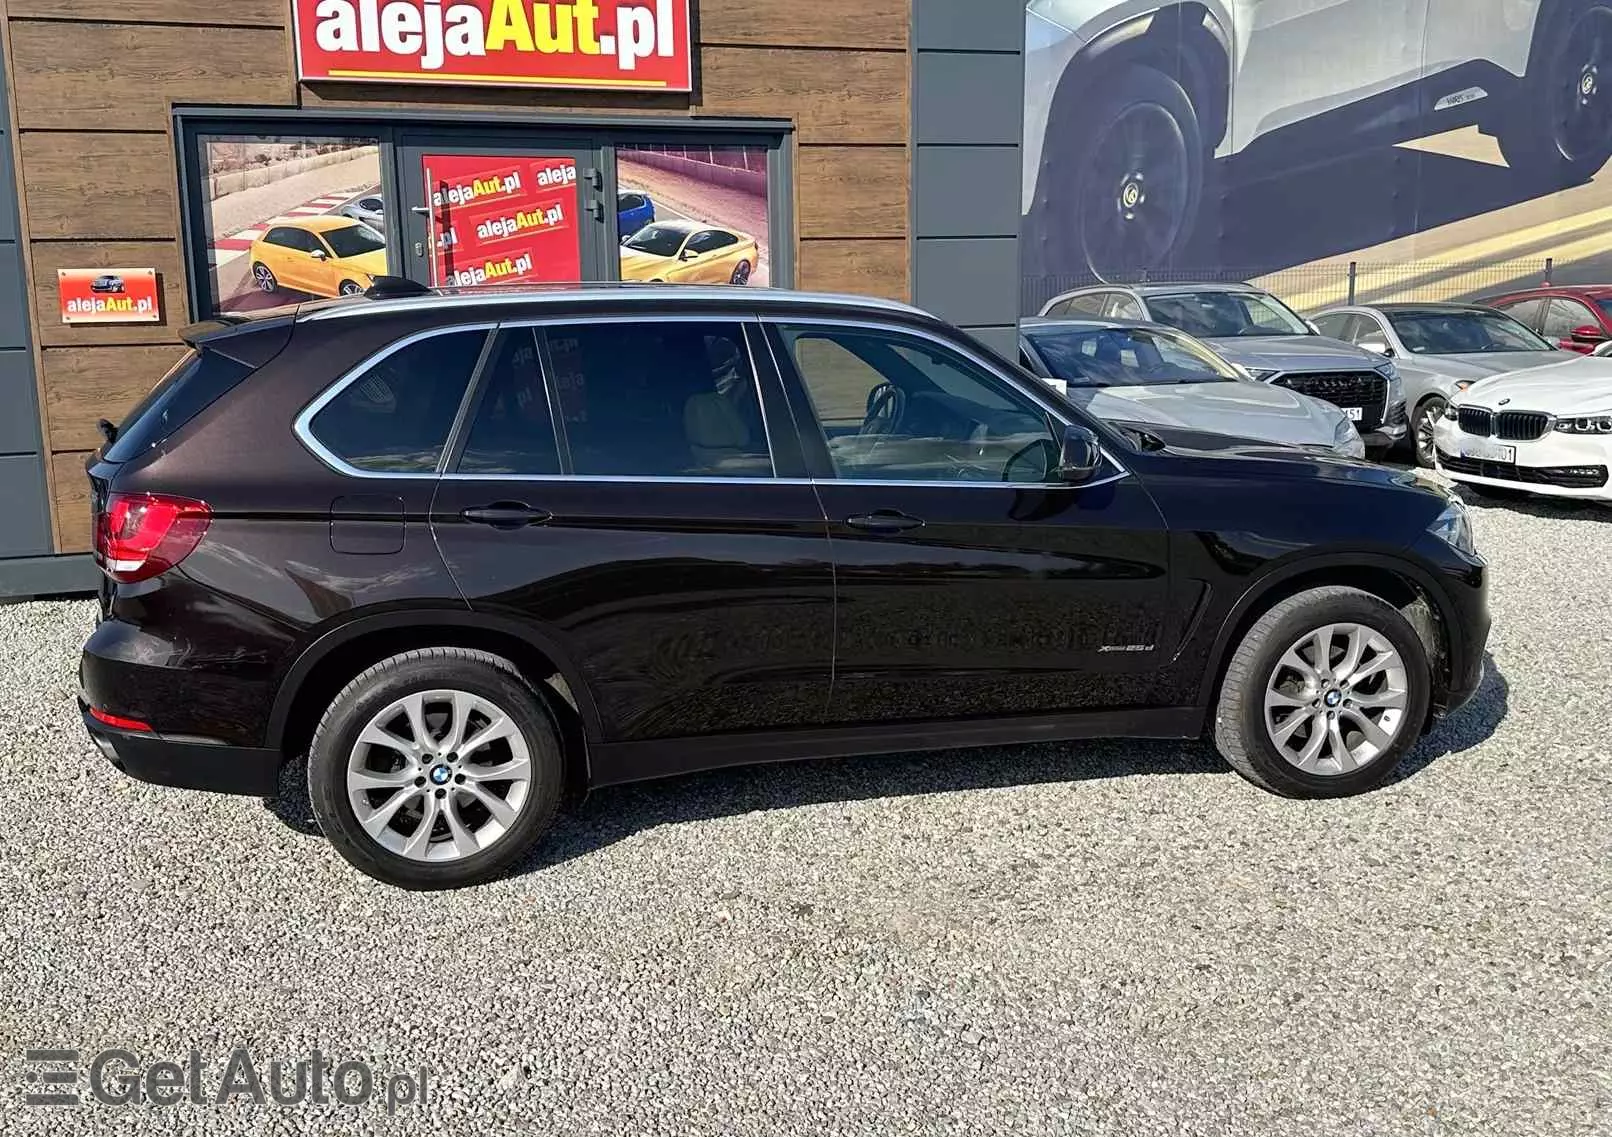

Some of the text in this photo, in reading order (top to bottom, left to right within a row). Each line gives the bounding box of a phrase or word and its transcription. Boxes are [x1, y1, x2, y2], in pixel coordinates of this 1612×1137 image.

[315, 0, 674, 70] alejaAut.pl
[433, 171, 521, 206] alejaAut.pl
[537, 164, 576, 186] aleja
[477, 204, 563, 239] alejaAut.pl
[446, 253, 533, 287] alejaAut.pl
[67, 296, 153, 314] alejaAut.pl
